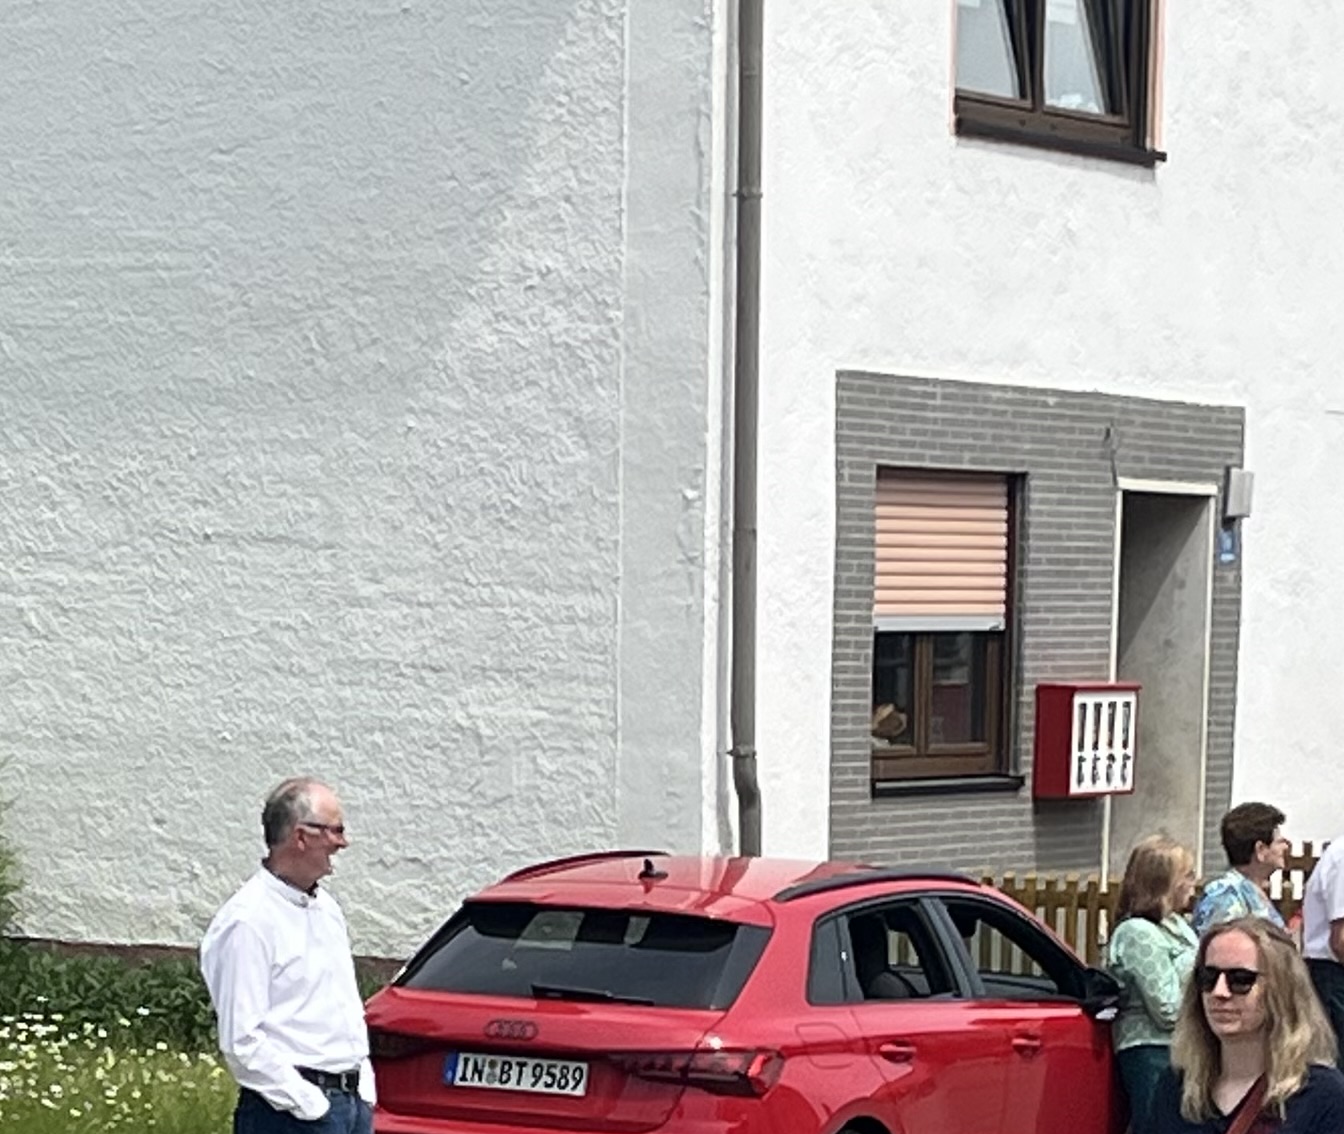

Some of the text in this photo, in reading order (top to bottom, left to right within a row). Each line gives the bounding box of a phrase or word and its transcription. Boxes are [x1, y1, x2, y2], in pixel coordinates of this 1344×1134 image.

[459, 1056, 585, 1092] IN BT 9589
